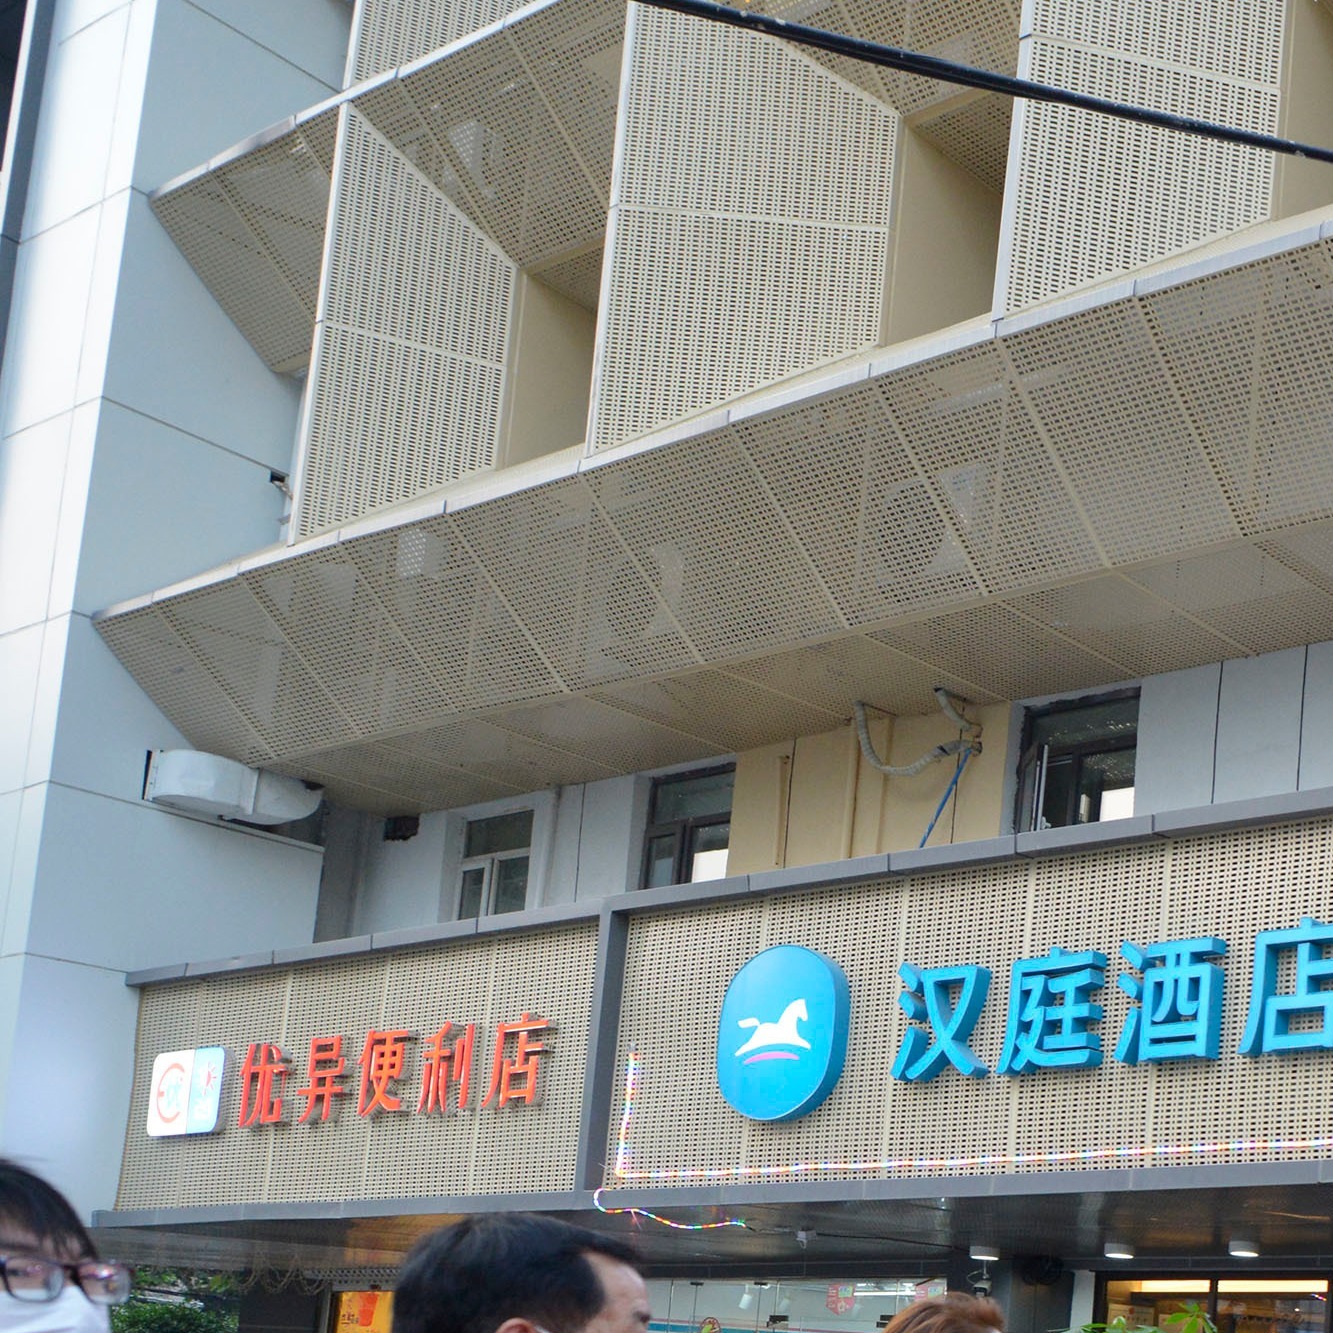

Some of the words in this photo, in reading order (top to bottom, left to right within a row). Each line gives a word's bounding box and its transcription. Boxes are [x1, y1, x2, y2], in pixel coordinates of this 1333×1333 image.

[238, 1012, 553, 1128] 优异便利店
